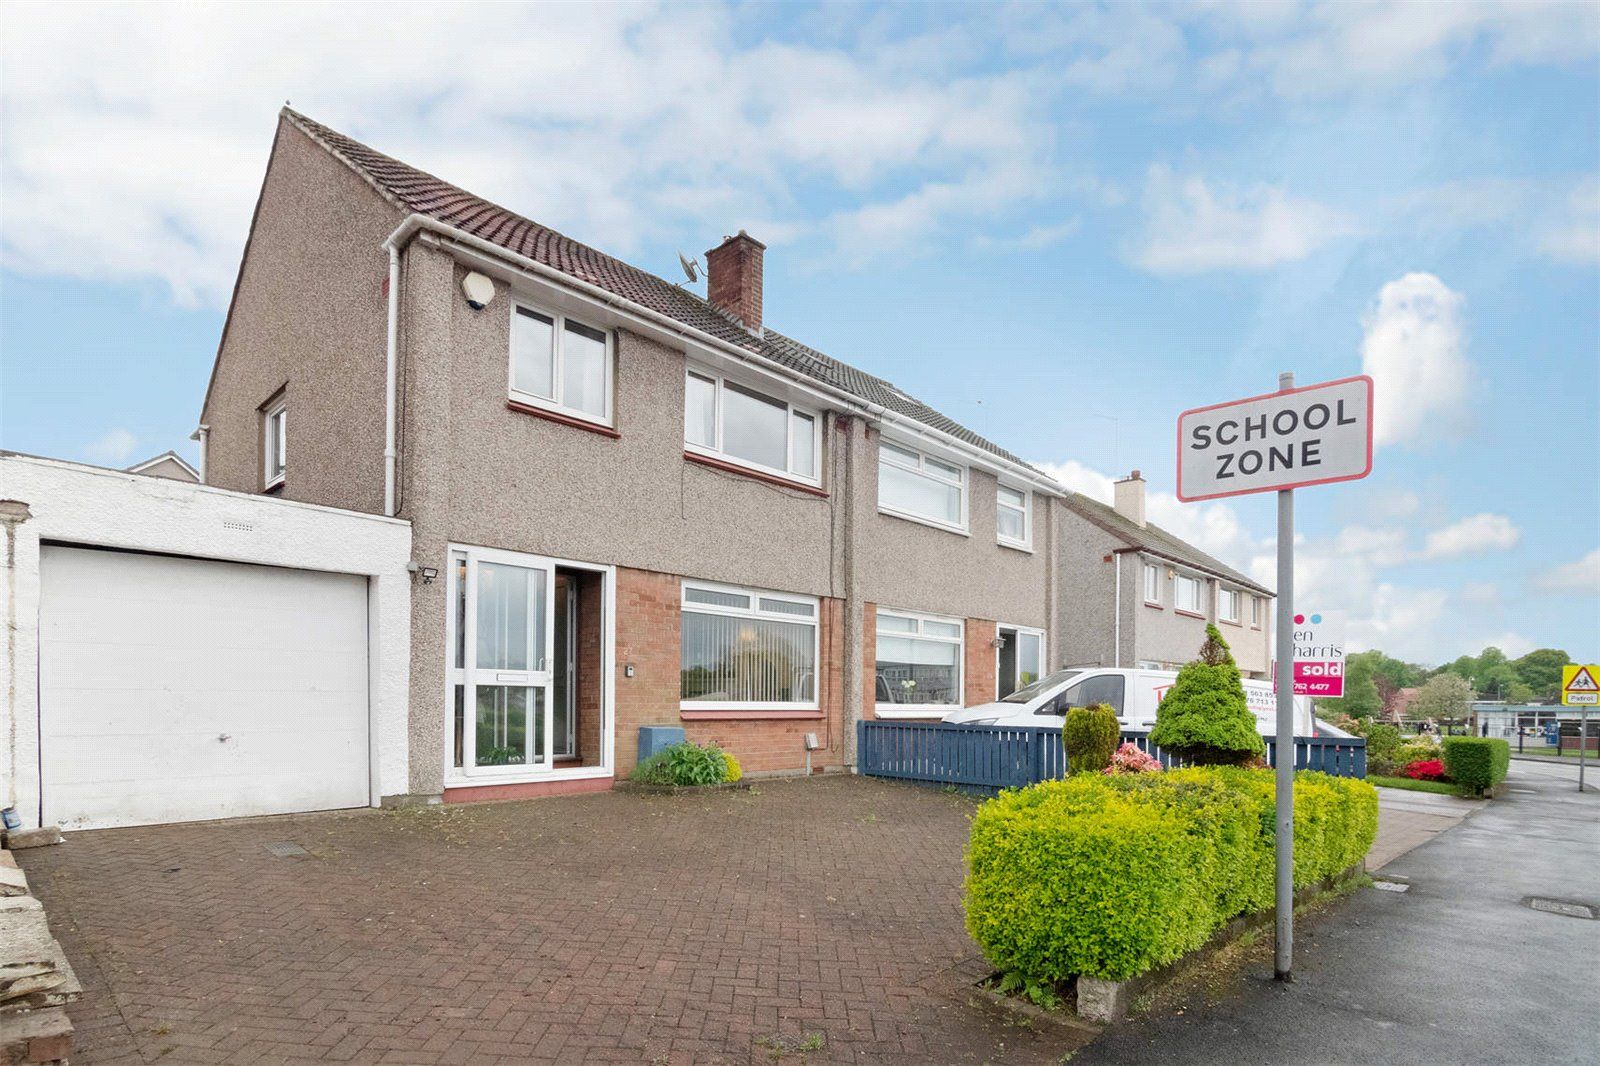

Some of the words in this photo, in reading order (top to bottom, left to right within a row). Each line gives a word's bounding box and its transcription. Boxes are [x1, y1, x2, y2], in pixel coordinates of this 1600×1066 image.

[1190, 399, 1356, 450] SCHOOL
[1216, 438, 1321, 480] ZONE
[1293, 643, 1342, 657] harris
[1302, 661, 1342, 676] sold
